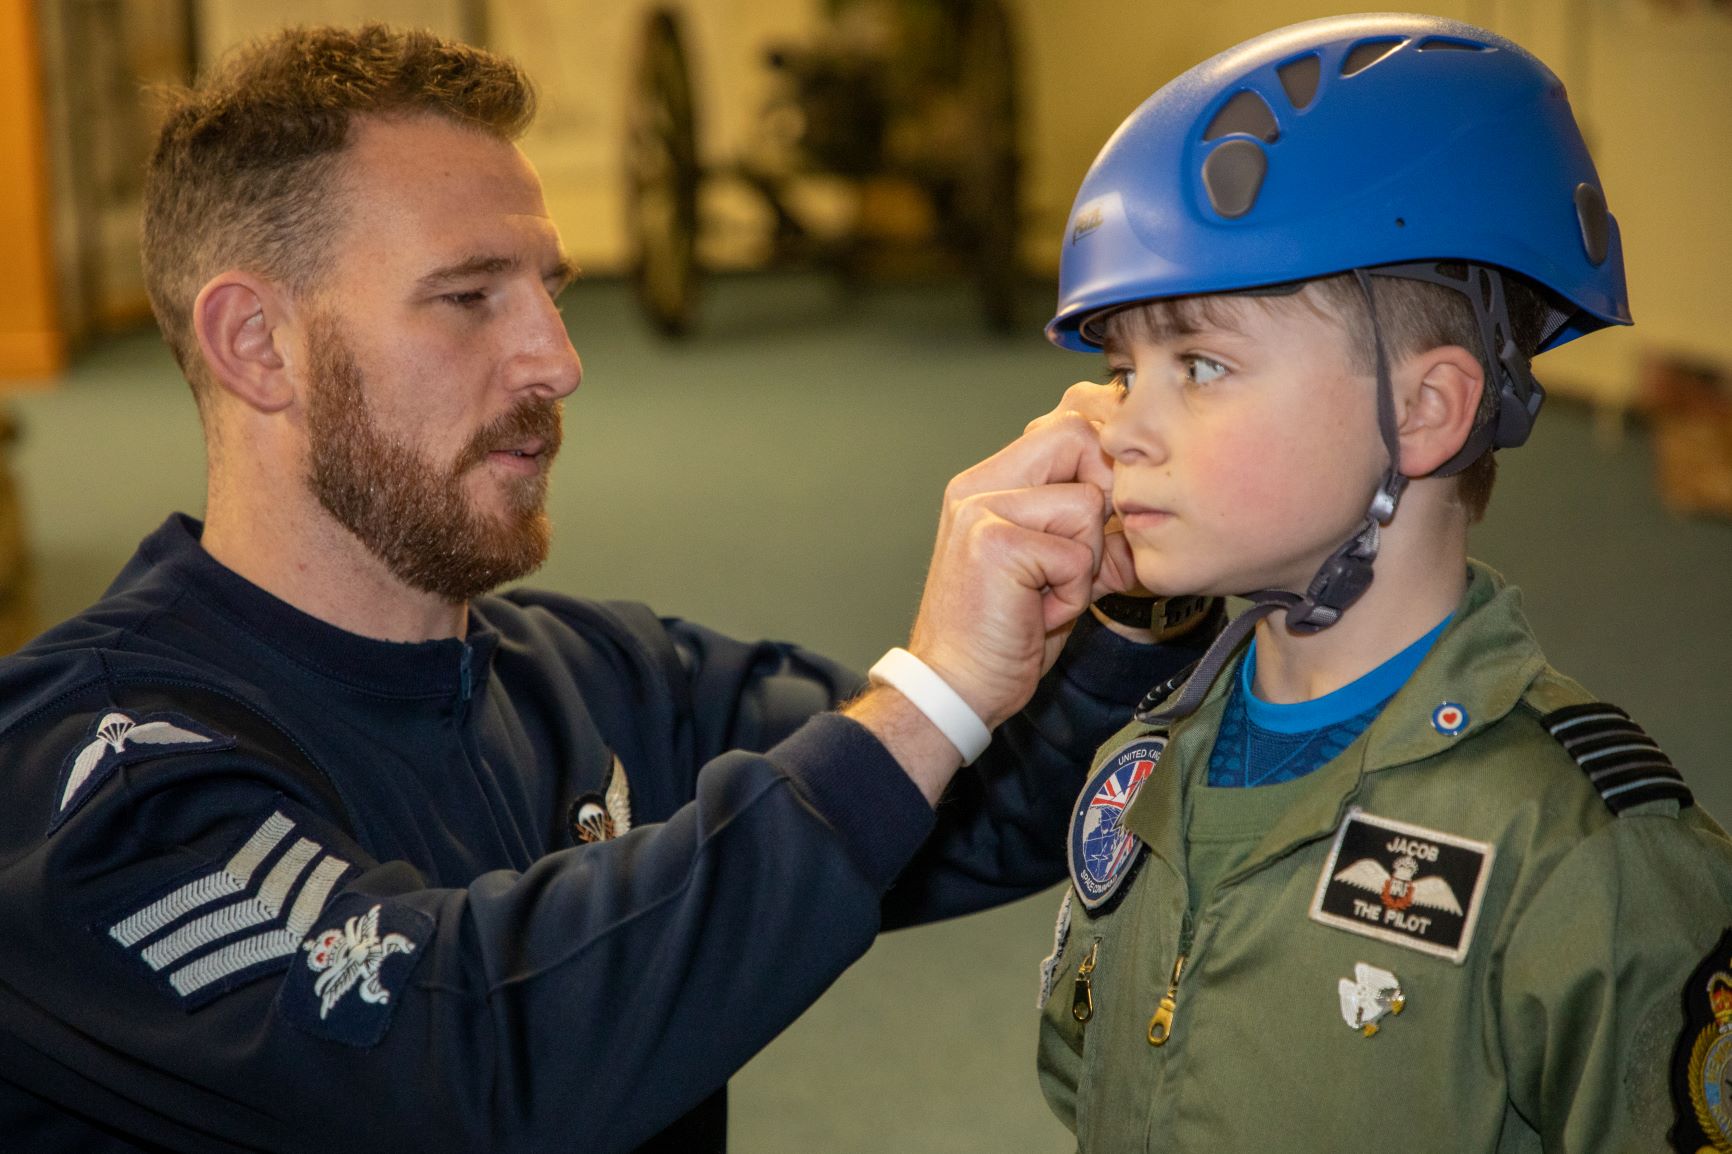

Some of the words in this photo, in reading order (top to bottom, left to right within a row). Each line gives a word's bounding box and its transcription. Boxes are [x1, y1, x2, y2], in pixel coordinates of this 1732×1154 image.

[1118, 749, 1147, 766] UNITED
[1148, 749, 1161, 761] KING
[1386, 837, 1440, 862] JACOB
[1080, 869, 1095, 892] SPACE
[1353, 899, 1382, 921] THE
[1384, 909, 1432, 934] PILOT
